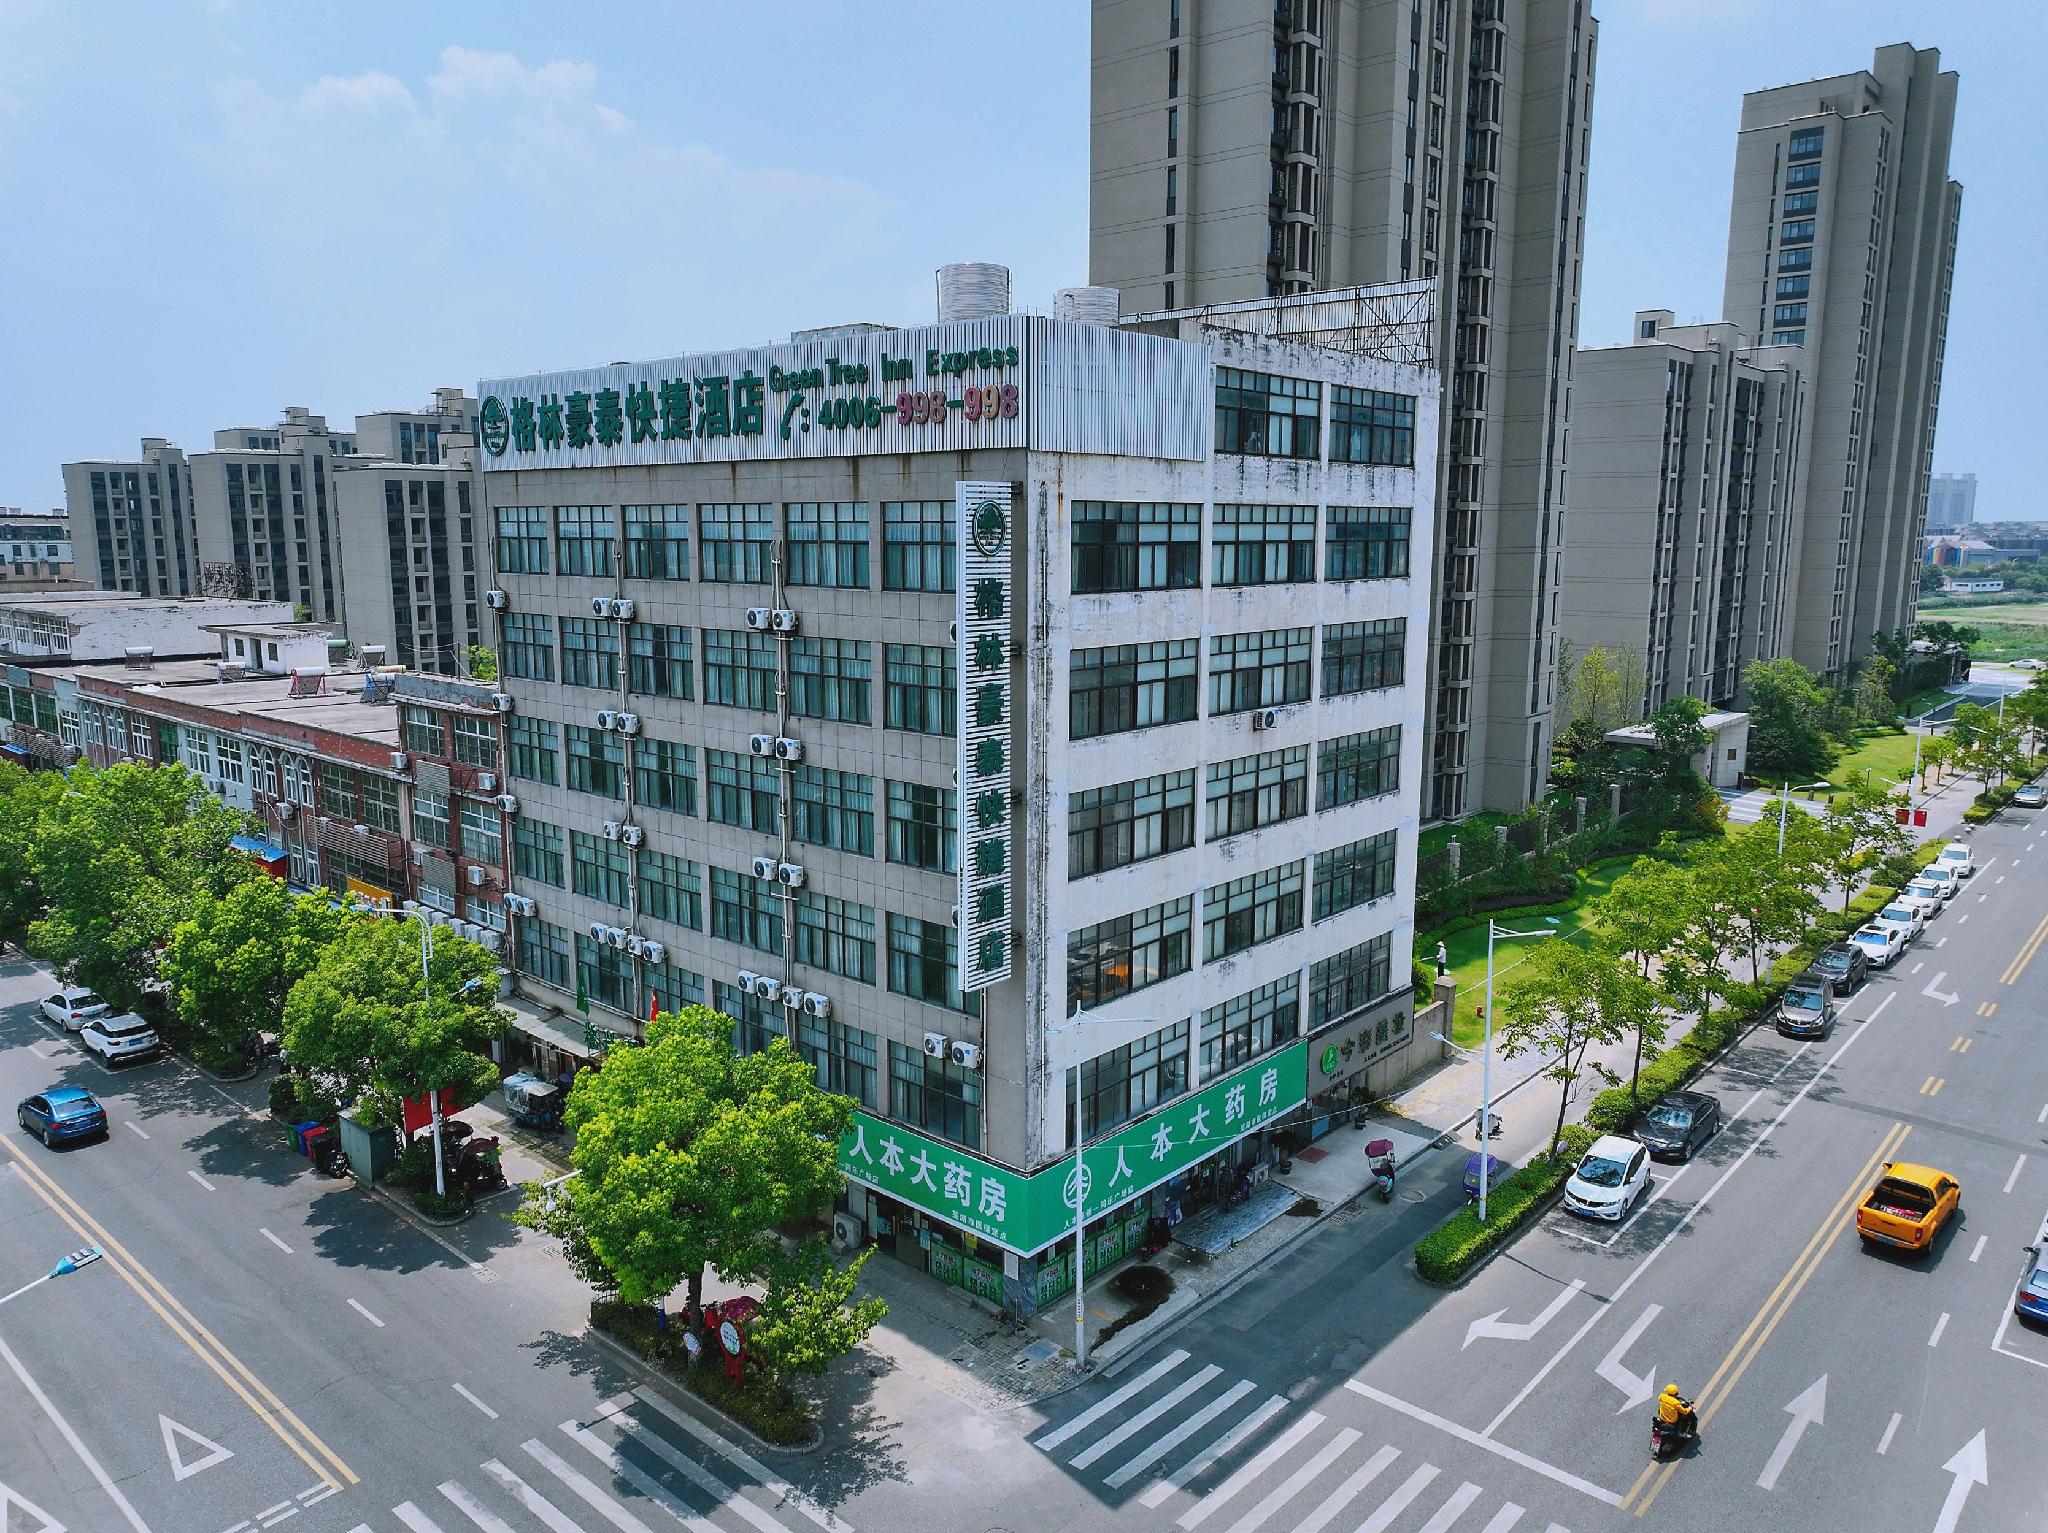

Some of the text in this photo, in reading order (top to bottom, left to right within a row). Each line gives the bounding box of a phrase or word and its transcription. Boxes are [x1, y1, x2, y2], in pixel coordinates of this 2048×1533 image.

[510, 370, 765, 452] 格林豪泰快捷酒店
[881, 352, 913, 382] Inn
[925, 345, 1019, 378] Express
[974, 577, 1006, 972] 格林豪泰快捷酒店
[850, 1125, 1008, 1222] 人本大药房
[1108, 1068, 1278, 1188] 人本大药房
